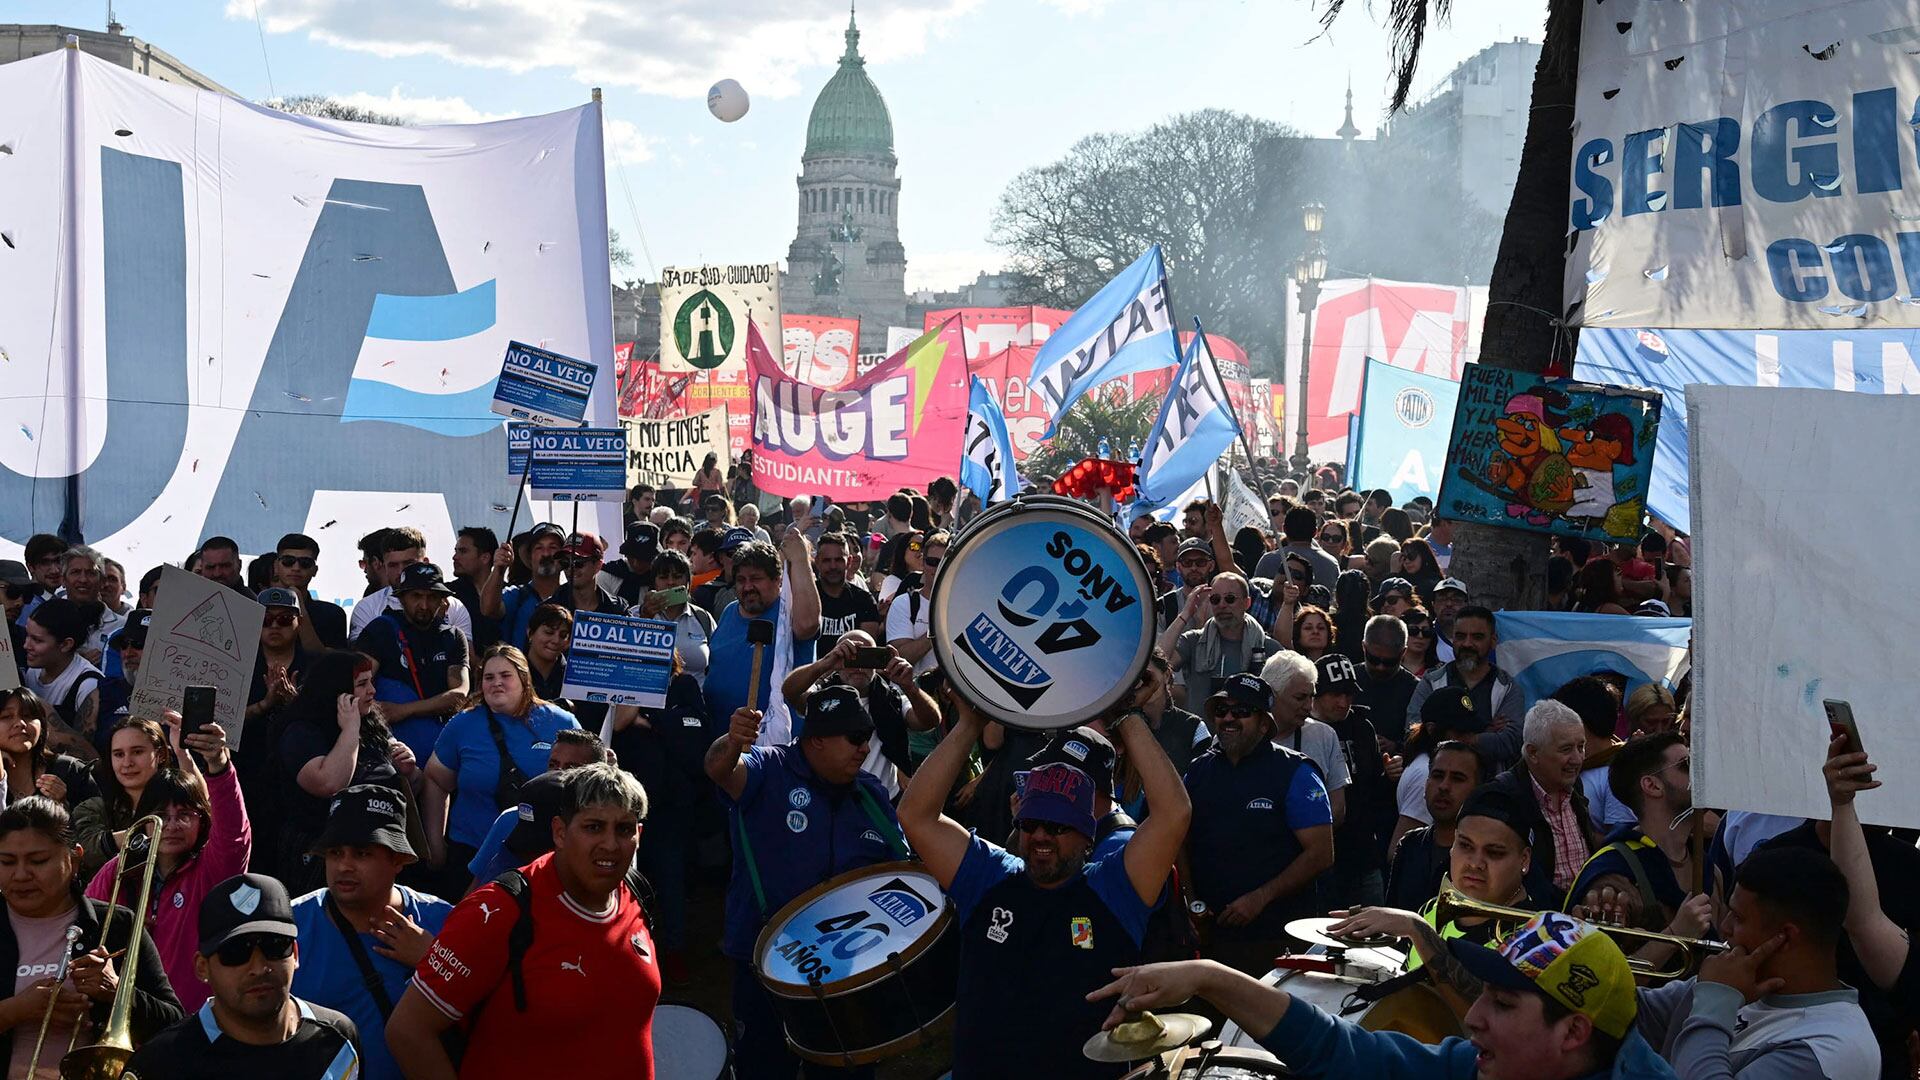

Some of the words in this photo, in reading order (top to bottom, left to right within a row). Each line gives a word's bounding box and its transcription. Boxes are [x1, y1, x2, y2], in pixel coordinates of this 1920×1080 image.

[1571, 86, 1920, 231] SERGI
[507, 350, 531, 367] NO
[533, 359, 552, 374] AL
[557, 364, 593, 385] VETO
[1468, 367, 1514, 391] FUERA
[754, 375, 908, 456] AUGE
[1401, 394, 1427, 421] FATUN
[509, 429, 530, 440] NO
[533, 436, 557, 449] NO
[561, 437, 581, 450] AL
[585, 438, 625, 450] VETO
[640, 421, 661, 448] NO
[667, 413, 710, 448] FINGE
[626, 449, 697, 473] MENCIA
[754, 456, 862, 488] ESTUDIANTIL
[637, 471, 670, 486] UNLP
[574, 493, 587, 501] 40
[1045, 531, 1136, 614] AÑOS
[602, 617, 628, 626] NACIONAL
[629, 621, 666, 630] UNIVERSITARIO
[998, 565, 1102, 655] 40
[574, 622, 602, 639] NO
[605, 626, 627, 643] AL
[633, 629, 674, 648] VETO
[820, 613, 857, 636] ERLAST
[975, 615, 1042, 684] A.T.U.N.Lu
[609, 694, 624, 704] 40
[367, 799, 394, 813] 100%
[814, 910, 890, 961] 40
[428, 953, 455, 982] Salud
[774, 939, 832, 987] AÑOS
